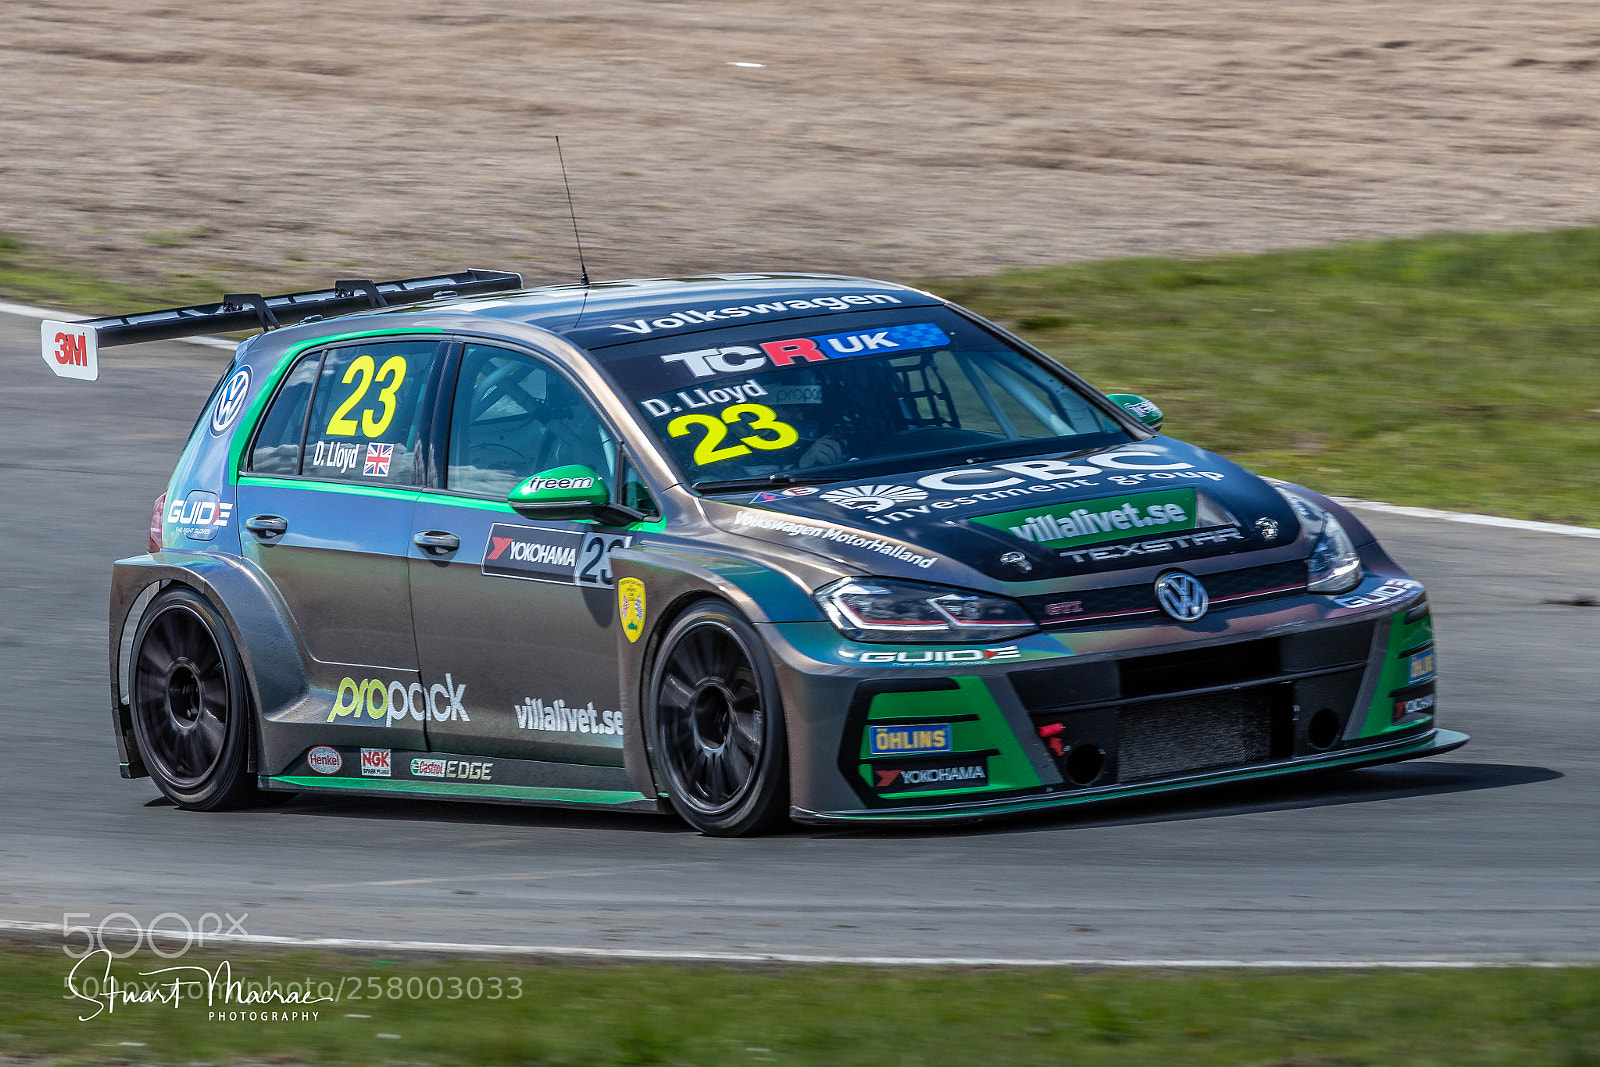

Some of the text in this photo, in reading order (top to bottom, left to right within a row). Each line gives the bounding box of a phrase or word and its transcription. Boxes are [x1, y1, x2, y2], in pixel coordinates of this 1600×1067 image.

[609, 294, 902, 336] Volkswagen
[54, 331, 87, 367] 3M
[661, 332, 901, 378] TCR UK
[326, 355, 406, 438] 23
[641, 379, 769, 417] D. Lloyd
[667, 403, 799, 466] 23
[313, 441, 361, 474] D. Lloyd
[915, 451, 1196, 491] CBC
[529, 476, 594, 492] freem
[865, 470, 1226, 526] investment group
[167, 500, 234, 527] GUIDE
[1009, 502, 1188, 543] villalivet.se
[509, 541, 577, 567] YOKOHAMA
[733, 510, 938, 569] Volkswagen MotorHalland
[1059, 527, 1246, 563] TEXSTAR
[859, 645, 1022, 663] GUIDE
[326, 673, 470, 728] propack
[514, 697, 624, 735] villalivet.se
[876, 728, 946, 750] ÖHLINS
[310, 754, 340, 766] Henkel
[362, 751, 389, 768] NGK
[419, 760, 493, 780] Castrol EDGE
[900, 765, 986, 784] YOKOHAMA
